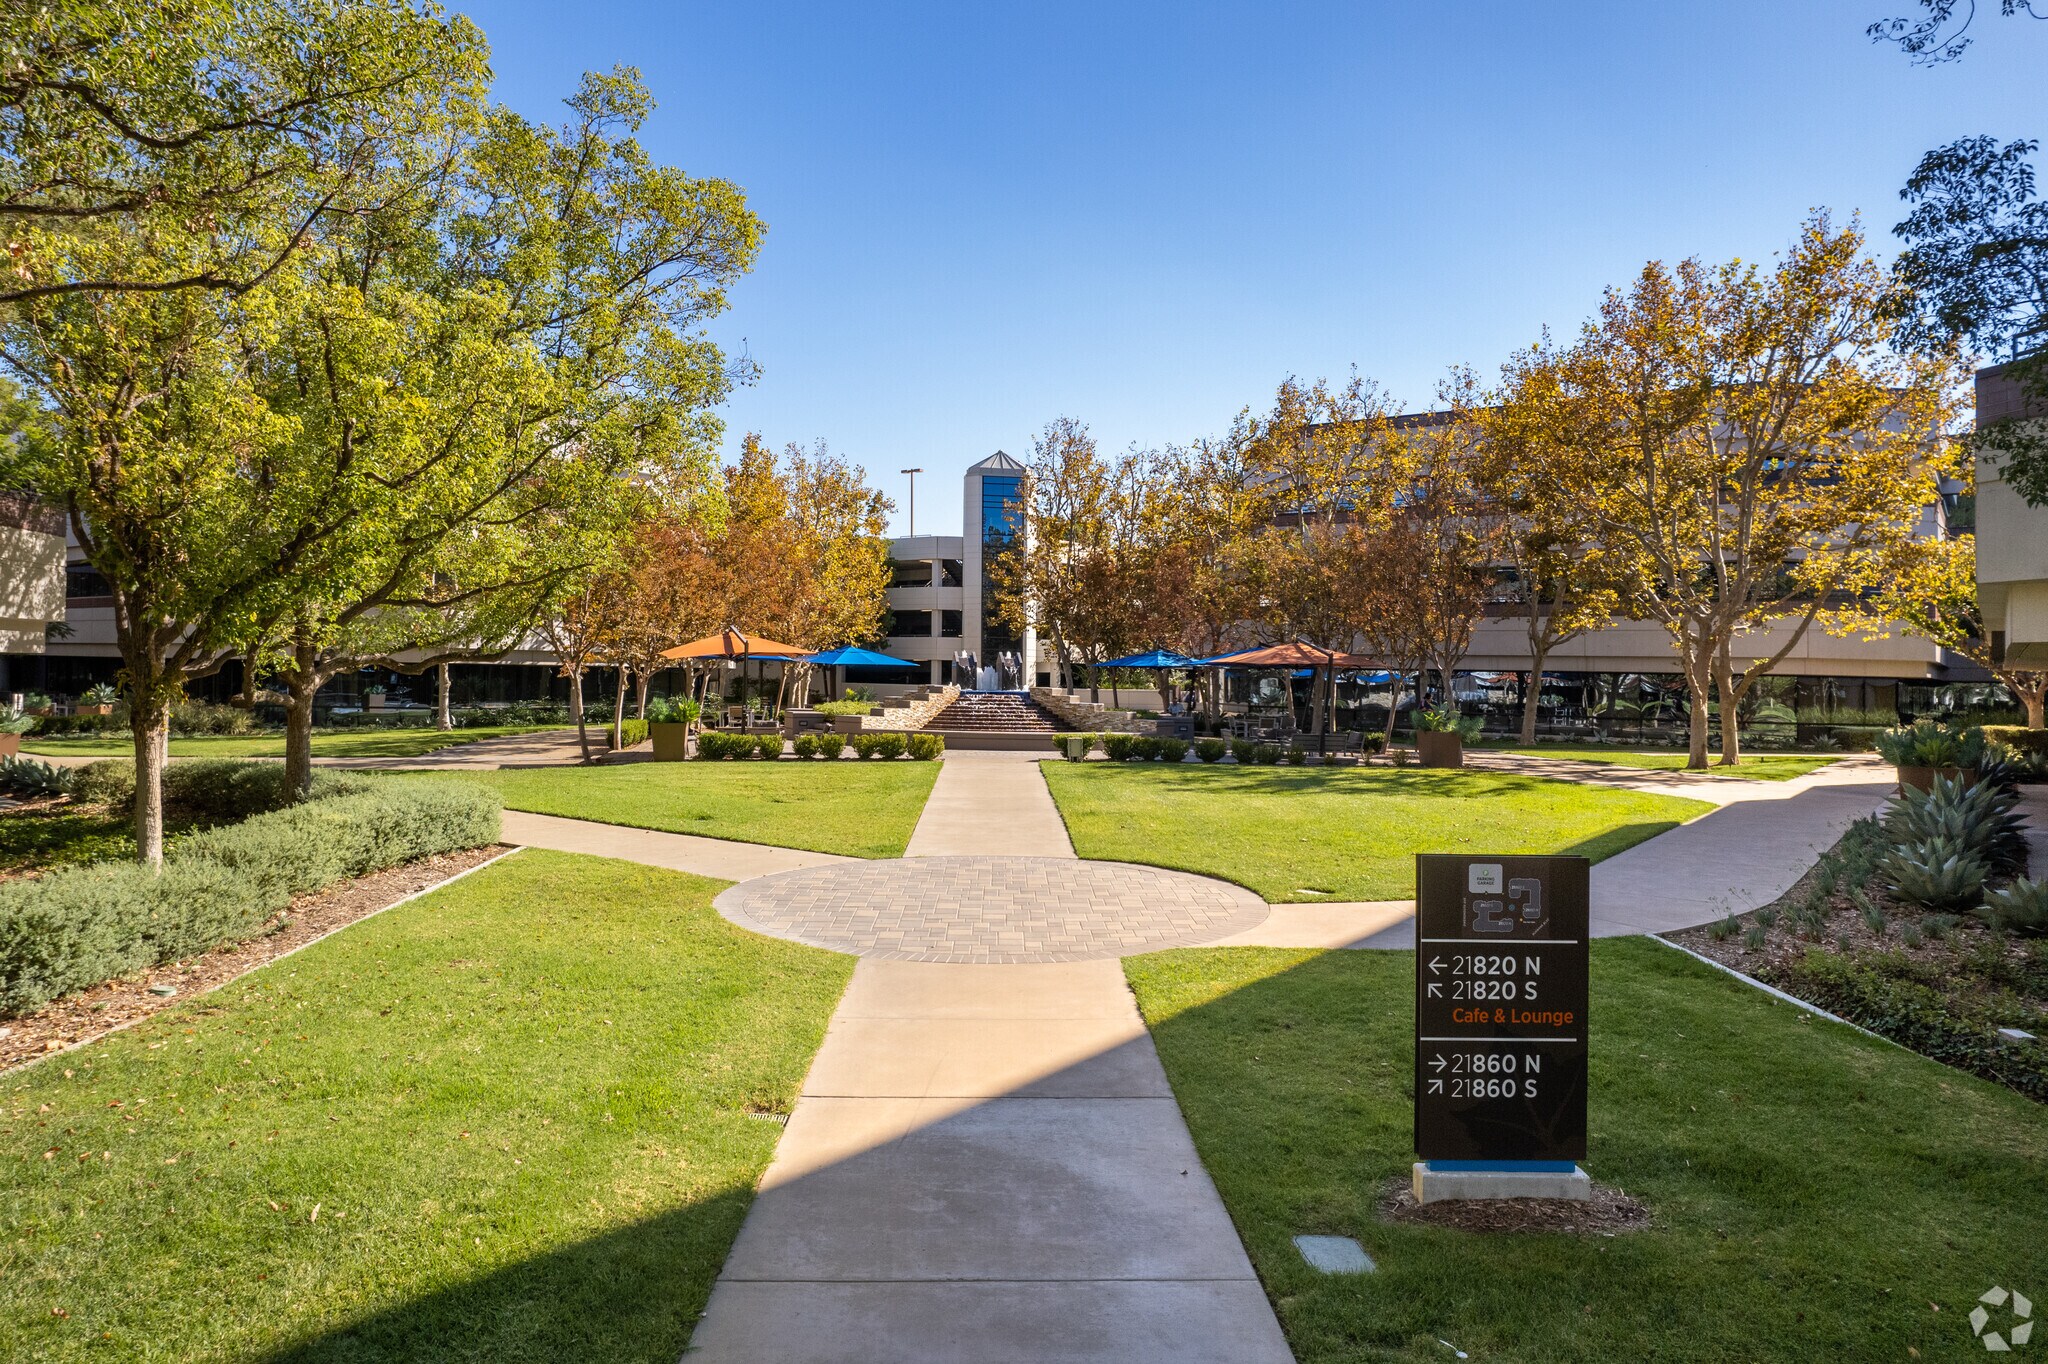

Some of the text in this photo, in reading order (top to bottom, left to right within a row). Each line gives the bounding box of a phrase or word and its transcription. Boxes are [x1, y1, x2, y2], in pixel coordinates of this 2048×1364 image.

[1452, 955, 1541, 976] 21820 N
[1452, 980, 1538, 1000] 21820 S
[1452, 1008, 1574, 1027] Cafe & Lounge
[1451, 1053, 1541, 1073] 21860 N
[1451, 1078, 1538, 1098] 21860 S
